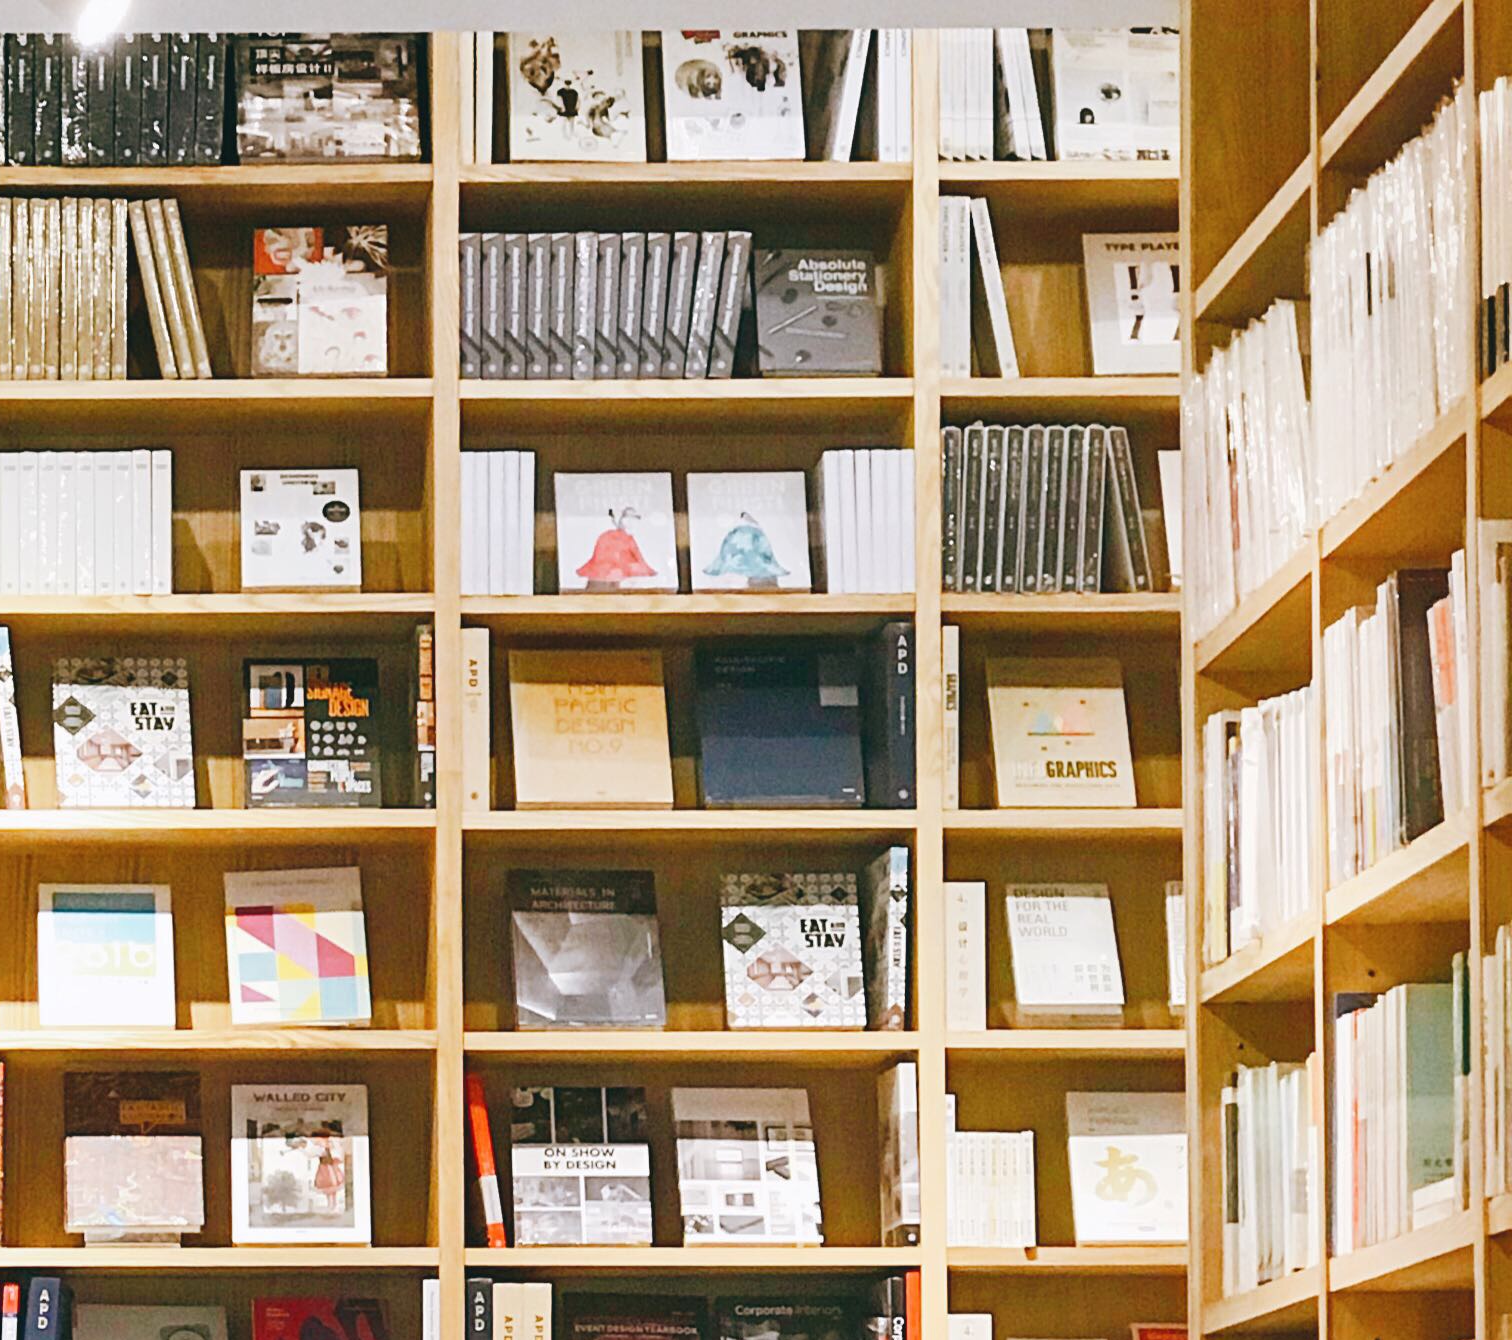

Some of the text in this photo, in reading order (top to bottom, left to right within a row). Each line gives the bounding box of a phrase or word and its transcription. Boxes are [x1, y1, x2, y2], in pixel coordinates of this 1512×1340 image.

[732, 31, 787, 39] GRAPHICS
[1104, 242, 1135, 251] TYPE
[797, 257, 866, 271] Absolute
[788, 269, 867, 284] Stationery
[814, 280, 867, 294] Design
[897, 634, 908, 675] APD
[130, 702, 157, 716] EAT
[328, 699, 369, 717] DESIGN
[554, 698, 636, 714] PACIFIC
[135, 717, 174, 731] STAY
[554, 718, 635, 735] DESIGN
[530, 887, 596, 897] MATERIALS
[1012, 887, 1066, 898] DESIGN
[1015, 901, 1069, 911] FOR THE
[800, 918, 828, 932] EAT
[1016, 913, 1050, 924] REAL
[1019, 926, 1067, 937] WORLD
[804, 933, 845, 947] STAY
[253, 1092, 346, 1103] WALLED CITY
[544, 1147, 615, 1158] ON SHOW
[544, 1160, 616, 1171] BY DESIGN
[1092, 1145, 1159, 1207] あ
[37, 1289, 50, 1330] APD
[473, 1291, 486, 1331] APD
[734, 1304, 793, 1317] Corporate
